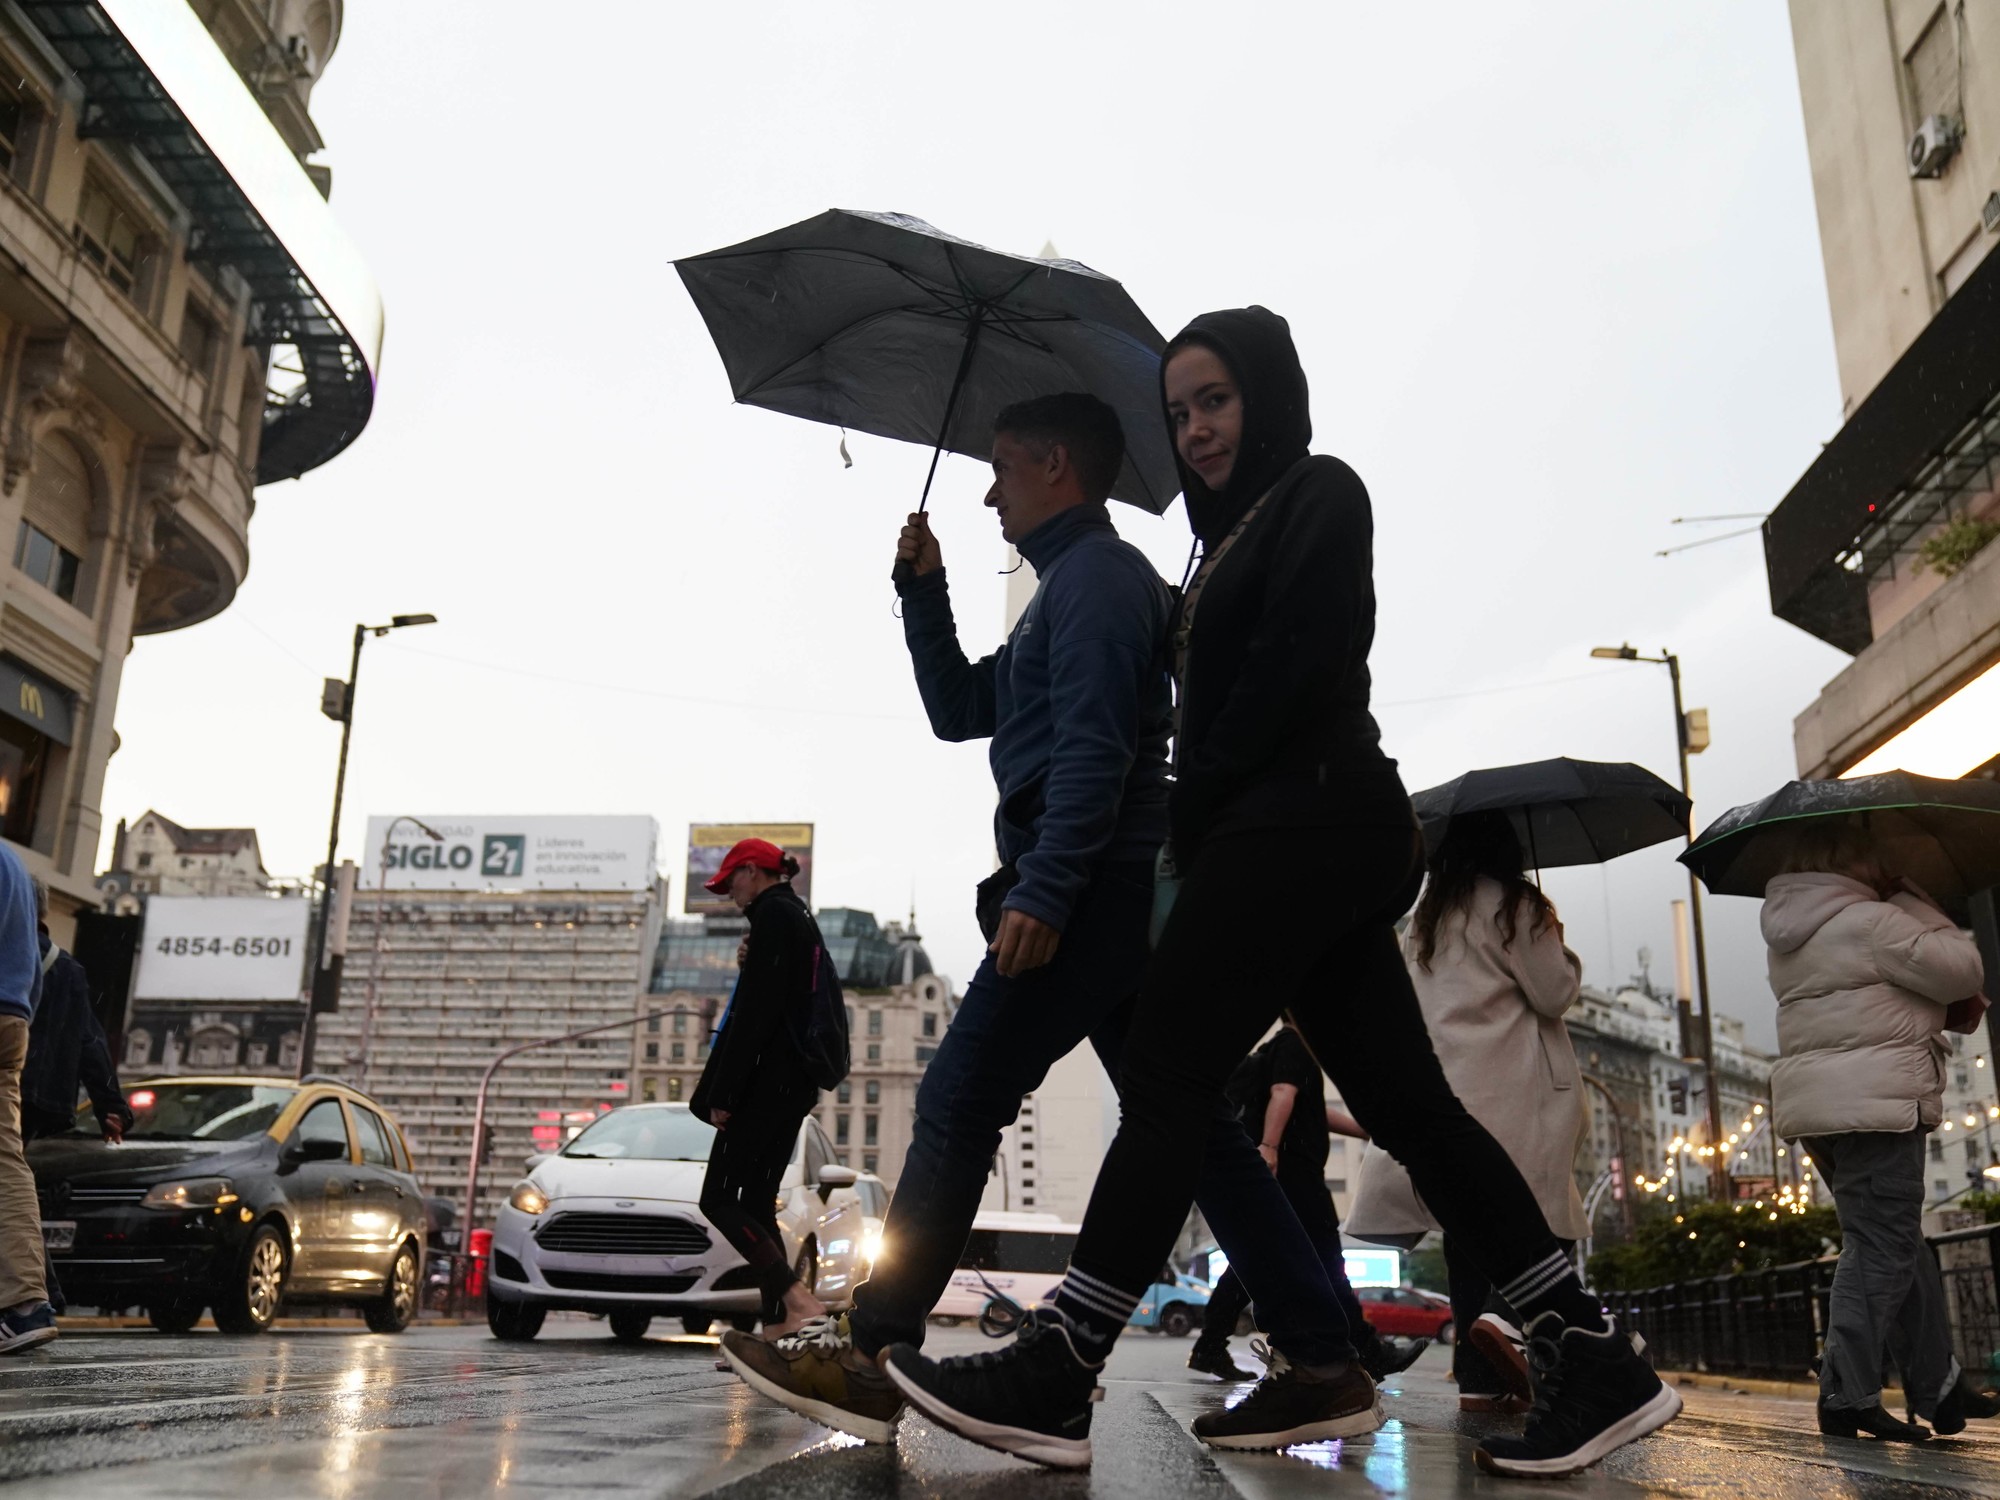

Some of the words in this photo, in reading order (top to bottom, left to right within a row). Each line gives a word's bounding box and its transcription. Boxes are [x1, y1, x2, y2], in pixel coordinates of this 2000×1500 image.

[380, 844, 473, 870] SIGLO
[485, 840, 520, 876] 21
[535, 851, 553, 861] en
[157, 937, 291, 956] 4854-6501
